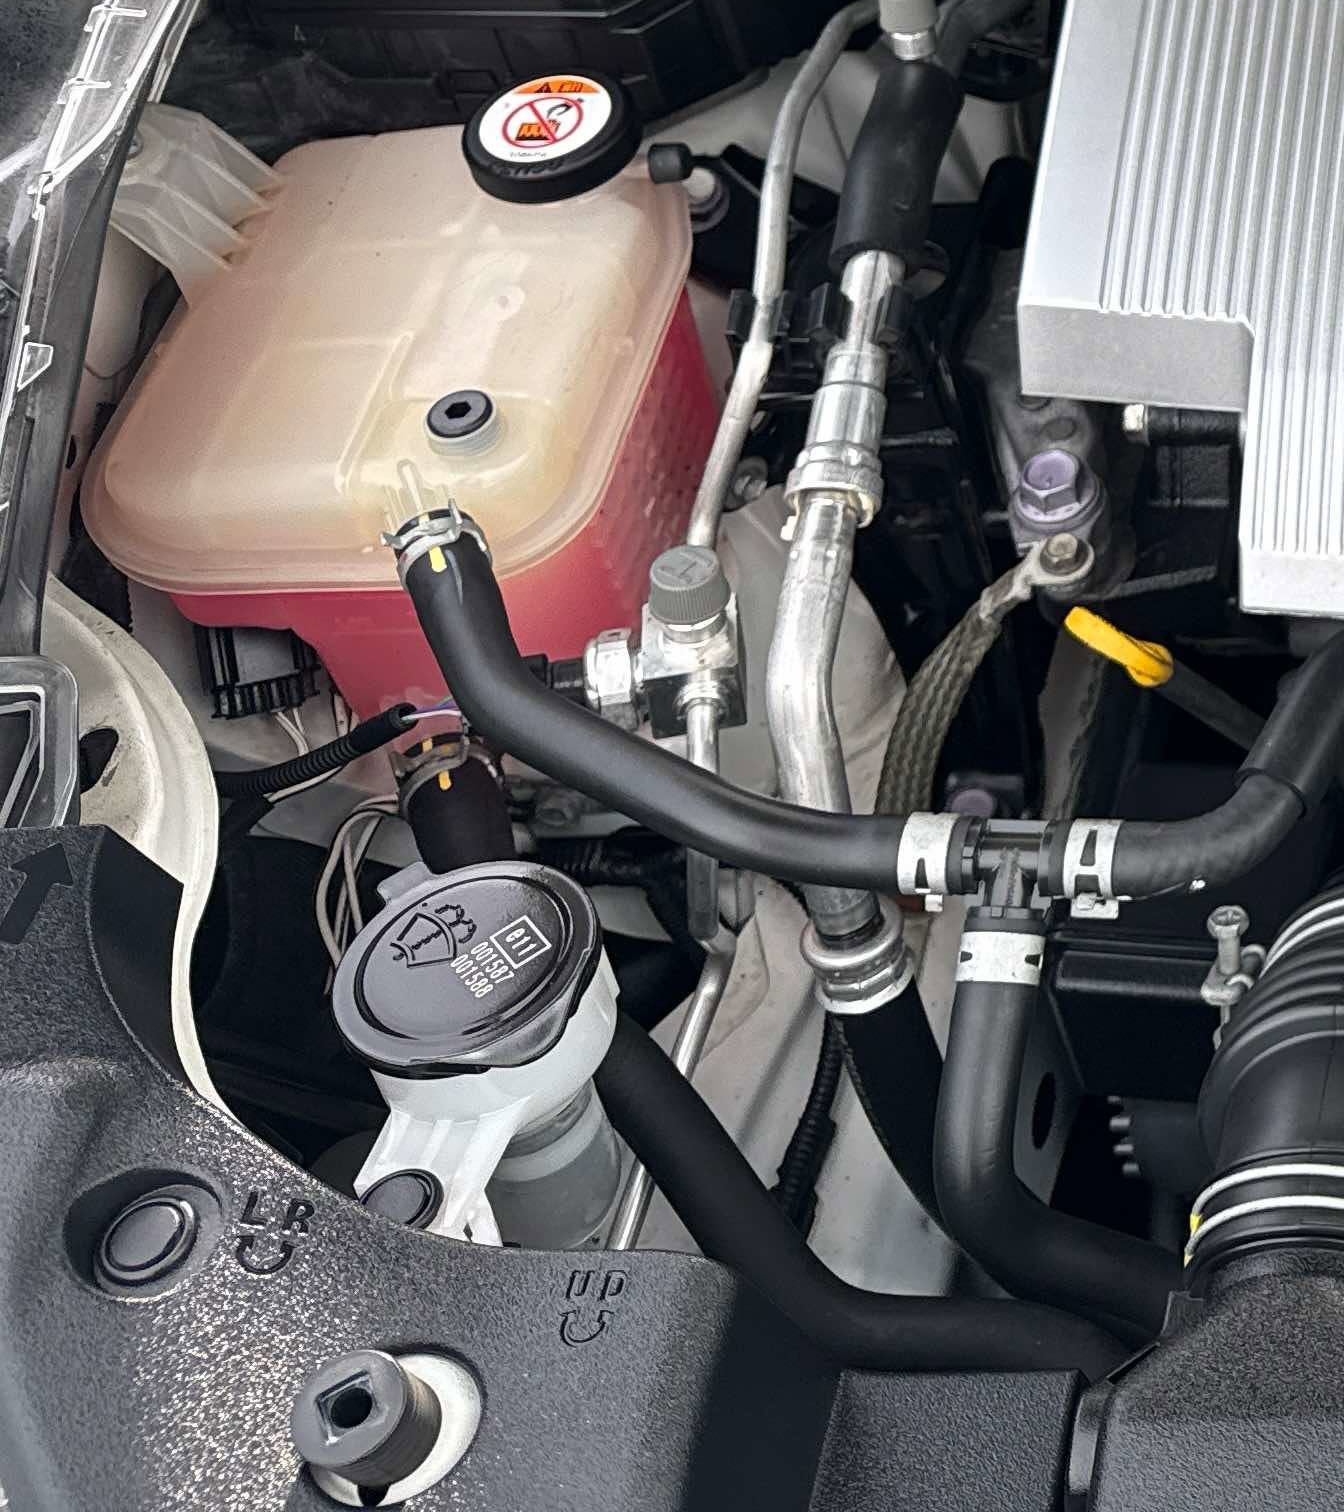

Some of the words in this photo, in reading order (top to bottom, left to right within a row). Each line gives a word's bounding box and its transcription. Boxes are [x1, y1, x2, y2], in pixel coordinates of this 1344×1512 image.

[470, 941, 515, 985] 001587
[505, 927, 537, 956] e11
[450, 953, 494, 999] 001588
[241, 1190, 268, 1226] L
[281, 1197, 315, 1234] R
